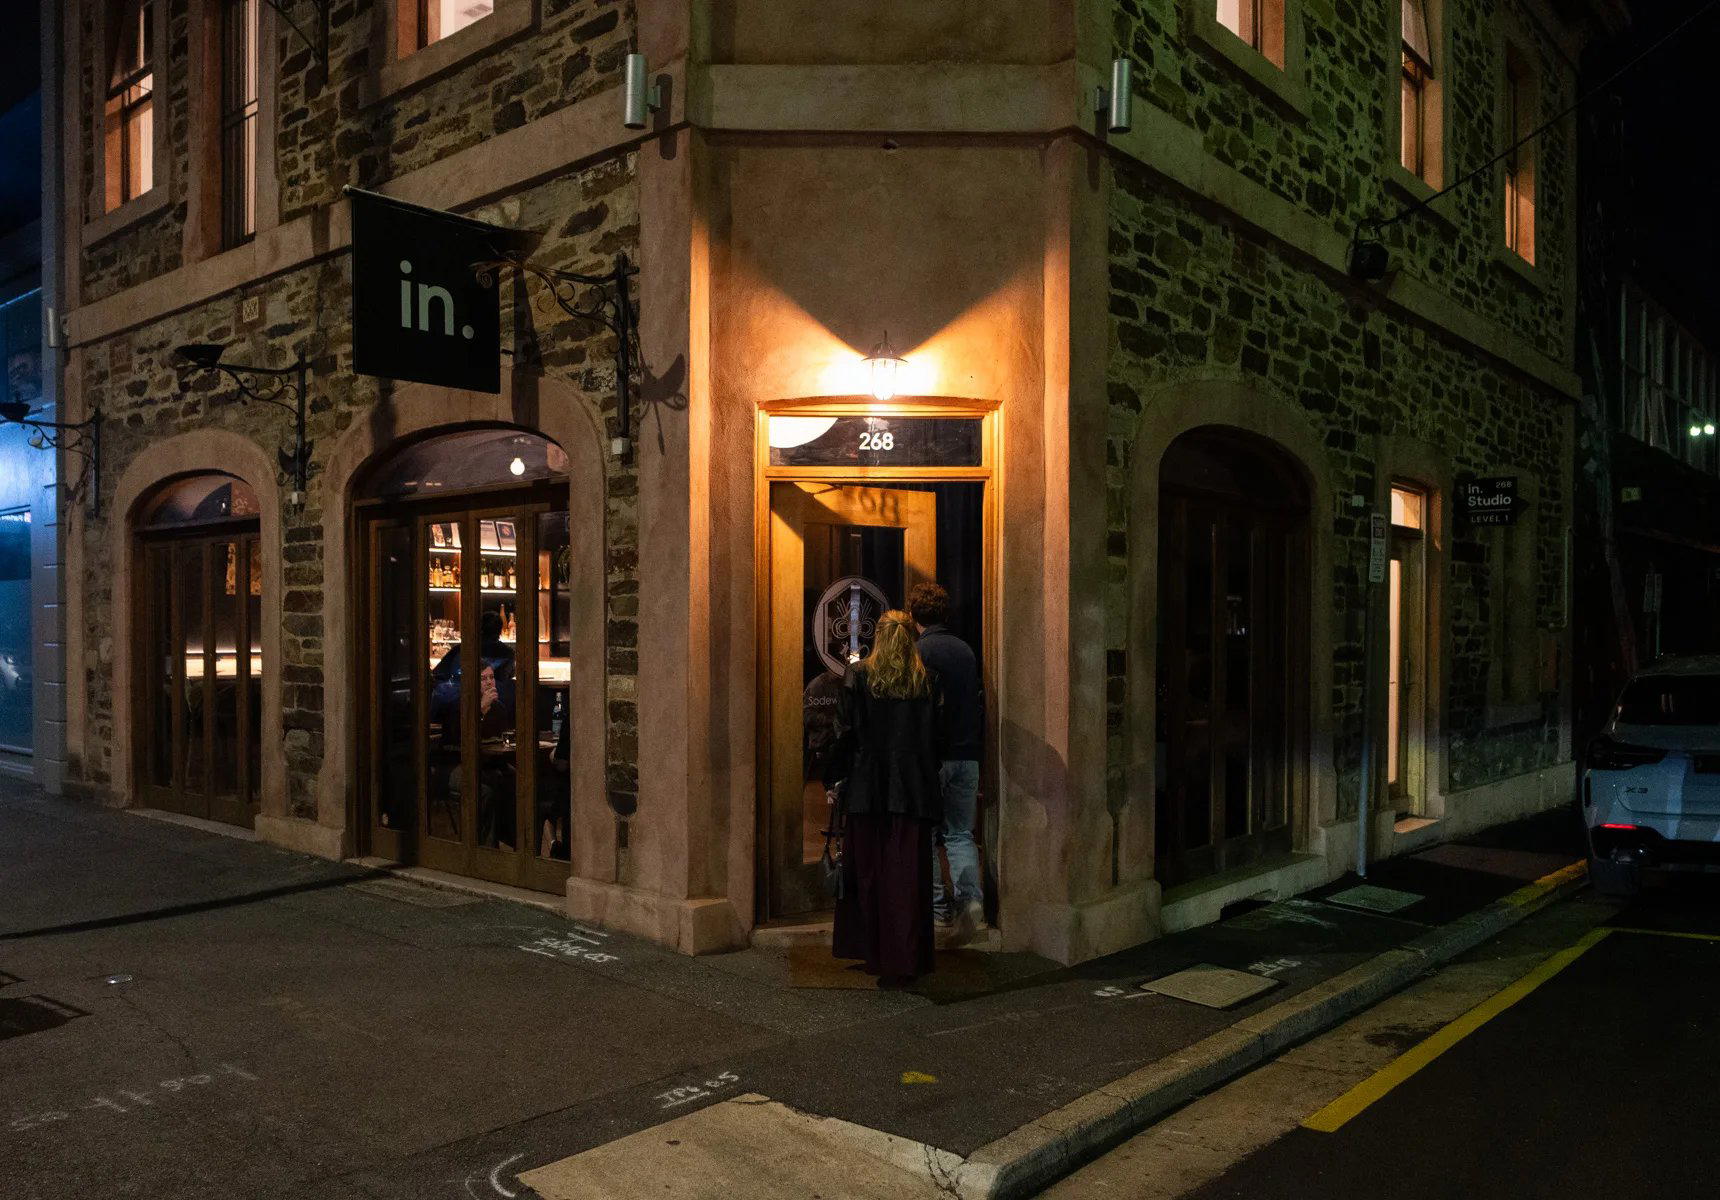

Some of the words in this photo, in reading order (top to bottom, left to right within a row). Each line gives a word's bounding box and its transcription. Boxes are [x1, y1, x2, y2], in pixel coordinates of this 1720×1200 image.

[399, 259, 475, 340] in.
[859, 432, 895, 451] 268
[1495, 480, 1512, 488] 268
[1467, 494, 1512, 507] Studio
[1471, 514, 1501, 523] LEVEL
